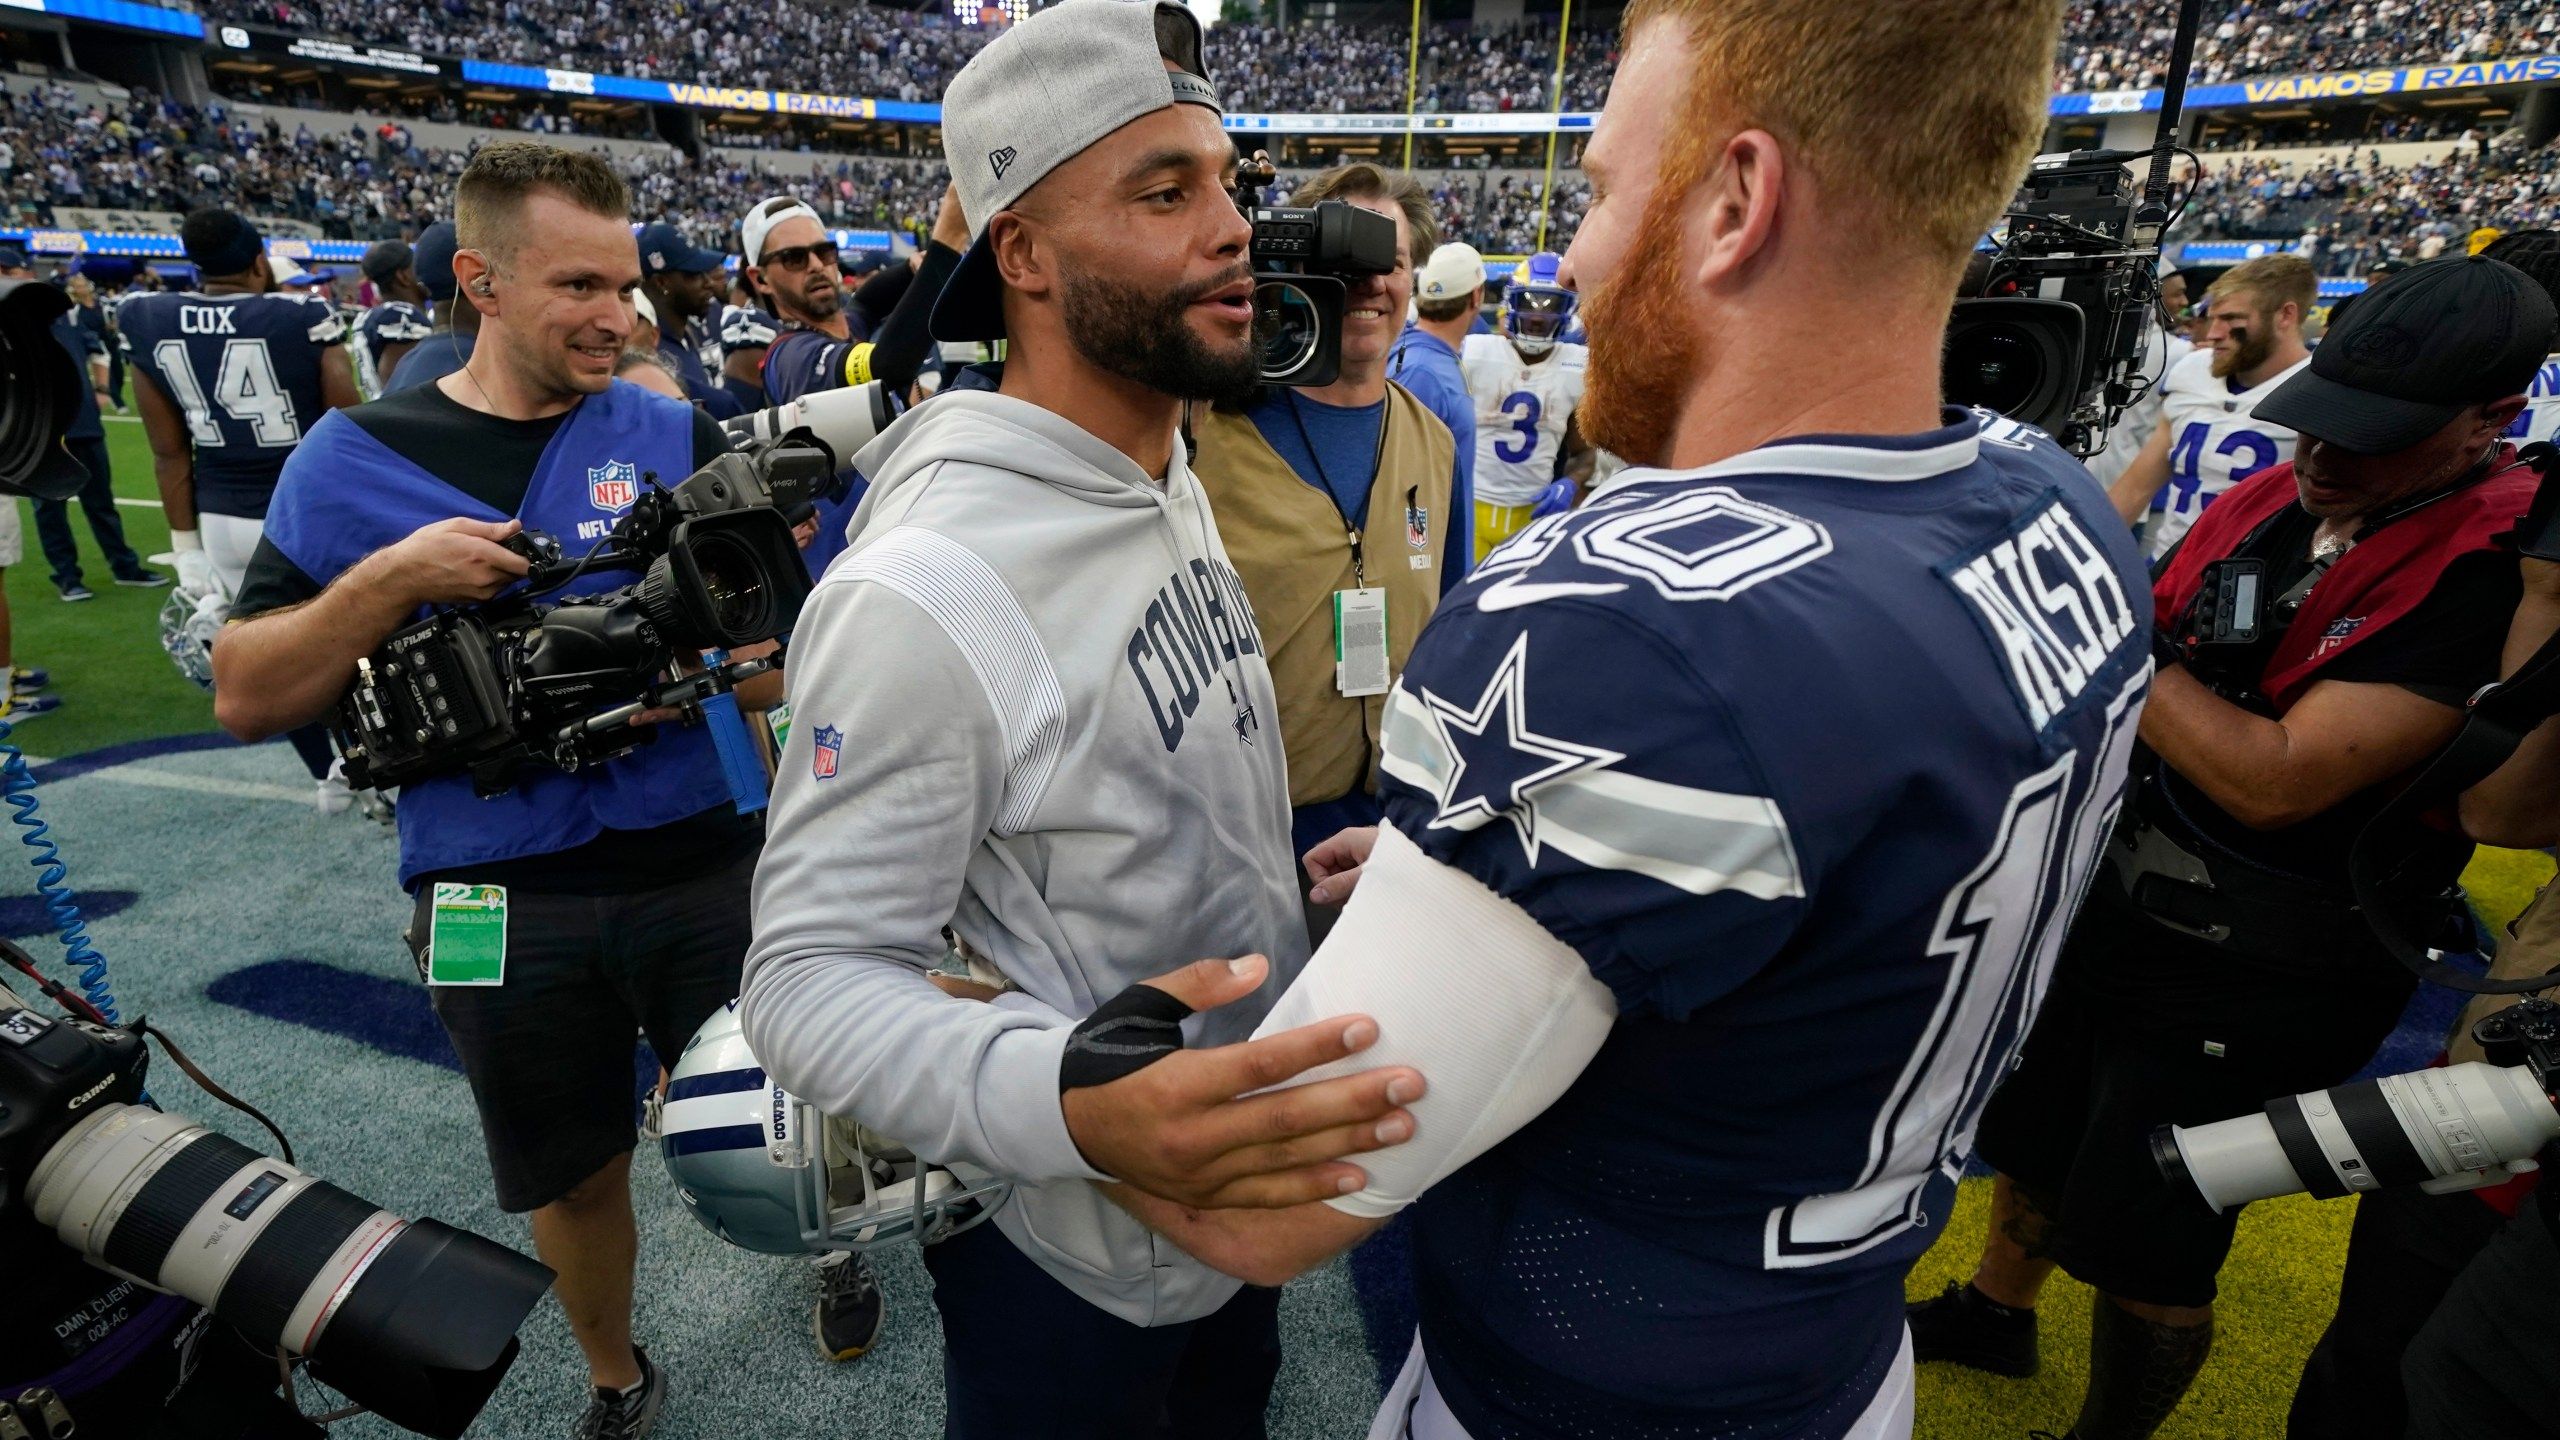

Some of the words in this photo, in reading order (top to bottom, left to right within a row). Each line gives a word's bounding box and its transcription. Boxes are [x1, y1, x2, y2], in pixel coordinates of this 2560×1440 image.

[668, 83, 770, 111] VAMOS
[788, 96, 865, 117] RAMS
[2246, 70, 2396, 103] VAMOS
[180, 305, 237, 334] COX
[153, 337, 301, 448] 14
[1494, 391, 1541, 464] 3
[2170, 421, 2278, 514] 43
[594, 482, 633, 506] NFL
[577, 519, 611, 540] NFL
[402, 627, 433, 648] FILMS
[814, 747, 834, 775] NFL
[67, 1072, 117, 1110] Canon
